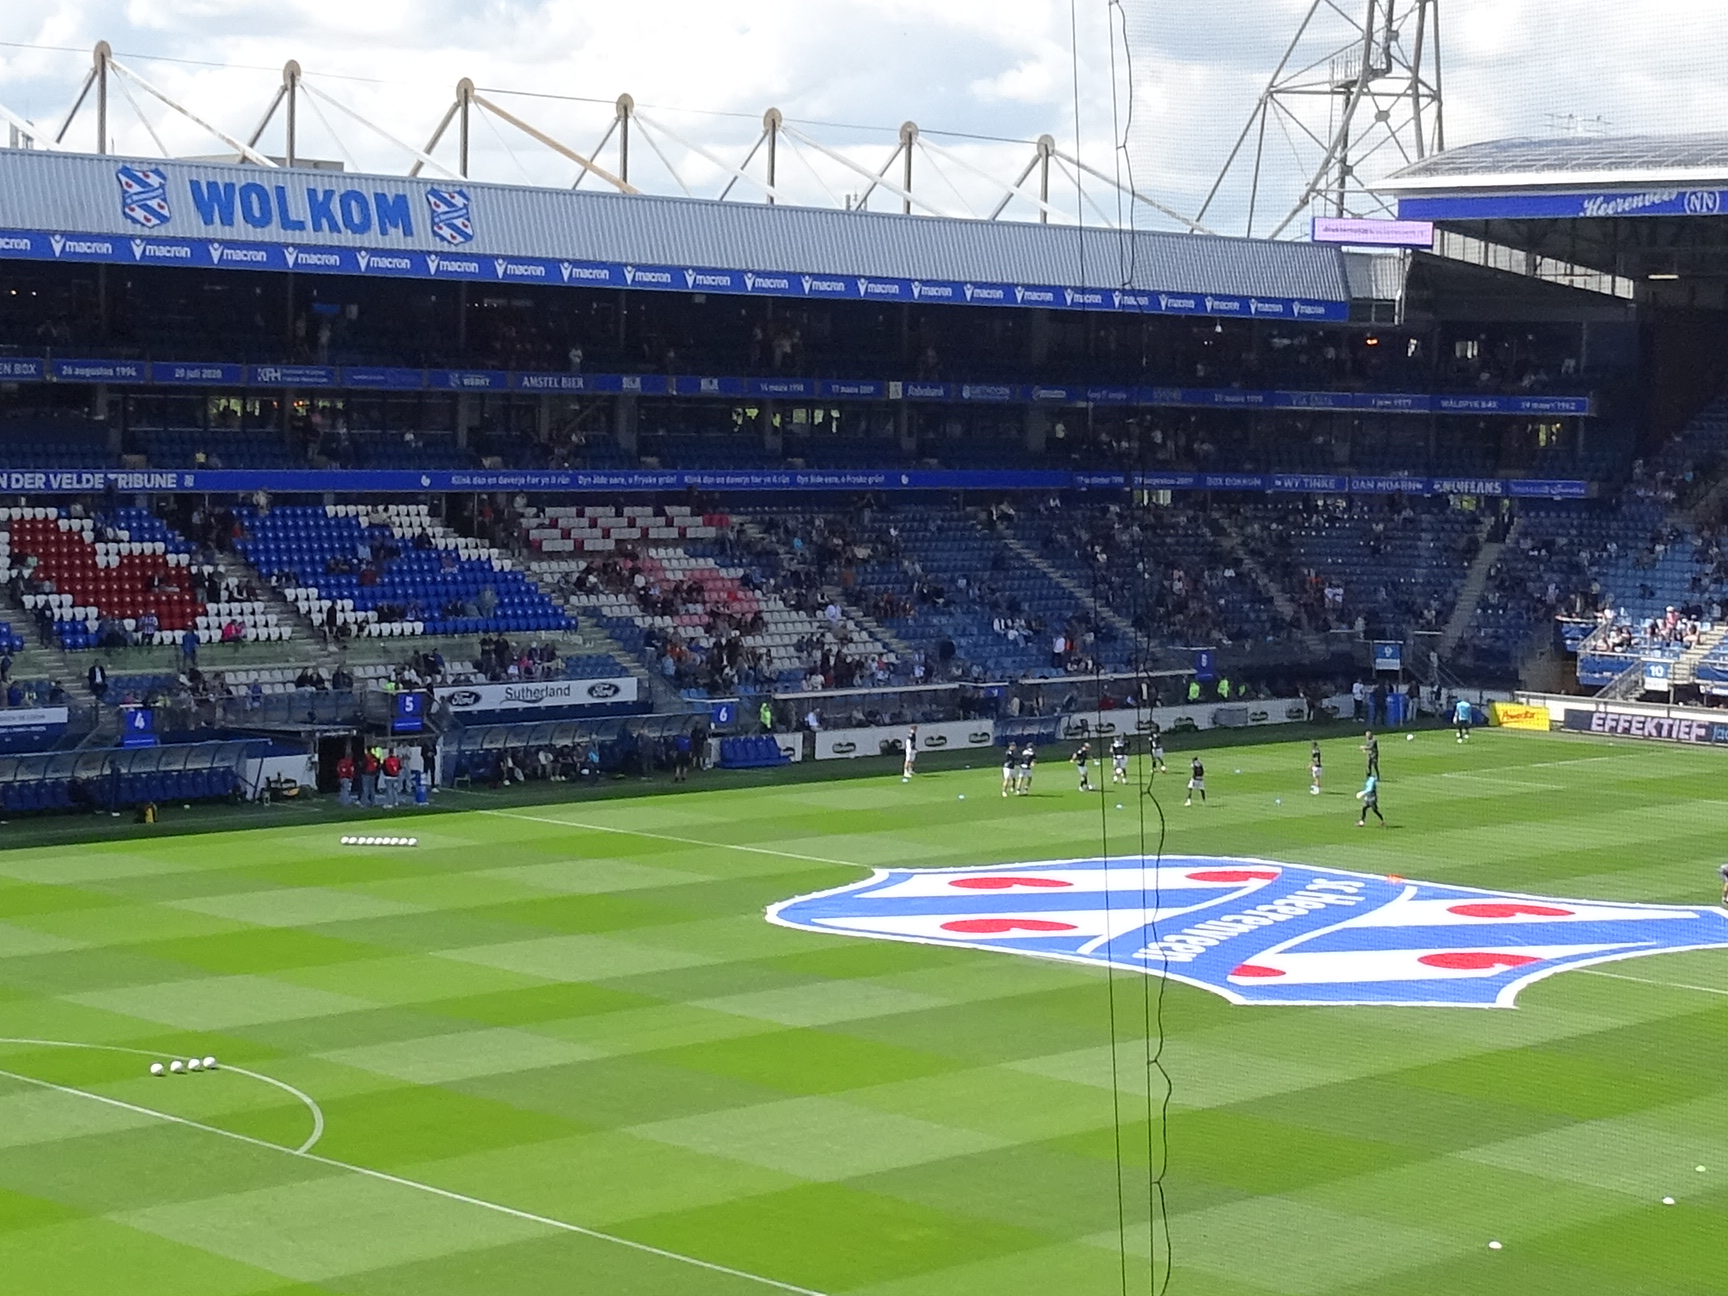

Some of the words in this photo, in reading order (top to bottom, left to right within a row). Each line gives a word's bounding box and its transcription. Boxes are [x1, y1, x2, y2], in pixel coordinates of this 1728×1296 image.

[189, 178, 415, 238] WOLKOM
[65, 240, 112, 254] macron
[145, 244, 191, 258] macron
[223, 248, 266, 262] macron
[298, 252, 340, 267] macron
[370, 256, 410, 270] macron
[439, 260, 479, 273] macron
[506, 264, 545, 277] macron
[572, 267, 609, 280] macron
[635, 271, 671, 283] macron
[695, 274, 731, 287] macron
[754, 277, 789, 290] macron
[811, 280, 845, 292] macron
[867, 283, 900, 295] macron
[921, 286, 953, 297] macron
[973, 288, 1004, 300] macron
[1024, 291, 1054, 302] macron
[13, 363, 37, 375] BOX
[522, 375, 560, 388] AMSTEL
[561, 376, 584, 389] BIER
[11, 473, 45, 489] DER
[49, 473, 104, 489] VELDE
[1283, 478, 1300, 488] WY
[1303, 479, 1336, 489] TINKE
[1351, 480, 1375, 491] OAN
[1377, 480, 1416, 491] MOARN
[1649, 664, 1664, 678] 10
[504, 683, 571, 702] Sutherland
[590, 683, 617, 697] Ford
[405, 695, 415, 712] 5
[450, 691, 479, 705] Ford
[134, 711, 145, 730] 4
[719, 706, 728, 723] 6
[1591, 712, 1709, 742] EFFEKTIEF
[1131, 890, 1366, 963] Heerenveen
